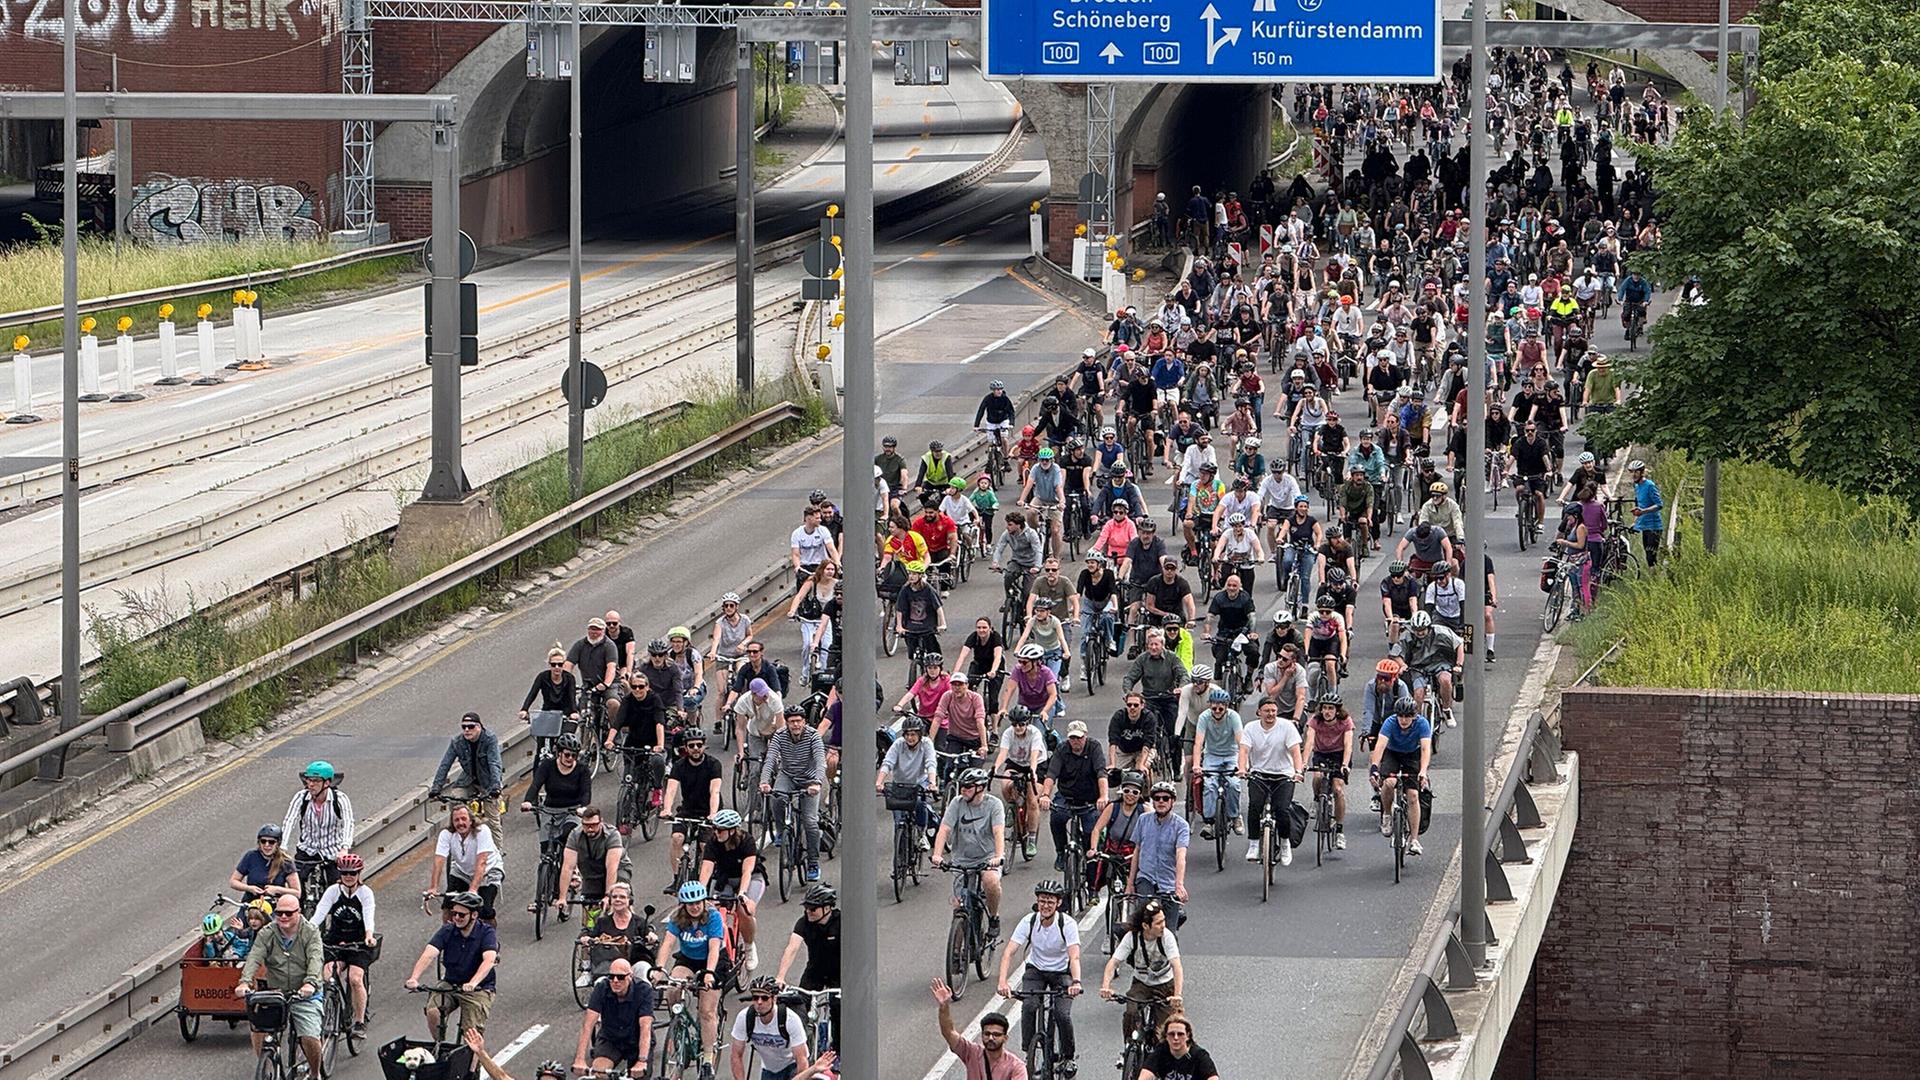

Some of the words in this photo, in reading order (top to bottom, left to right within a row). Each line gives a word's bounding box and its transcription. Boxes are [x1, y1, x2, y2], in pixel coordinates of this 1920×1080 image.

[1052, 10, 1171, 33] Schöneberg
[1252, 20, 1423, 39] Kurfürstendamm
[1049, 46, 1073, 60] 100
[1150, 46, 1174, 60] 100
[1252, 51, 1275, 65] 150
[1278, 54, 1293, 65] m
